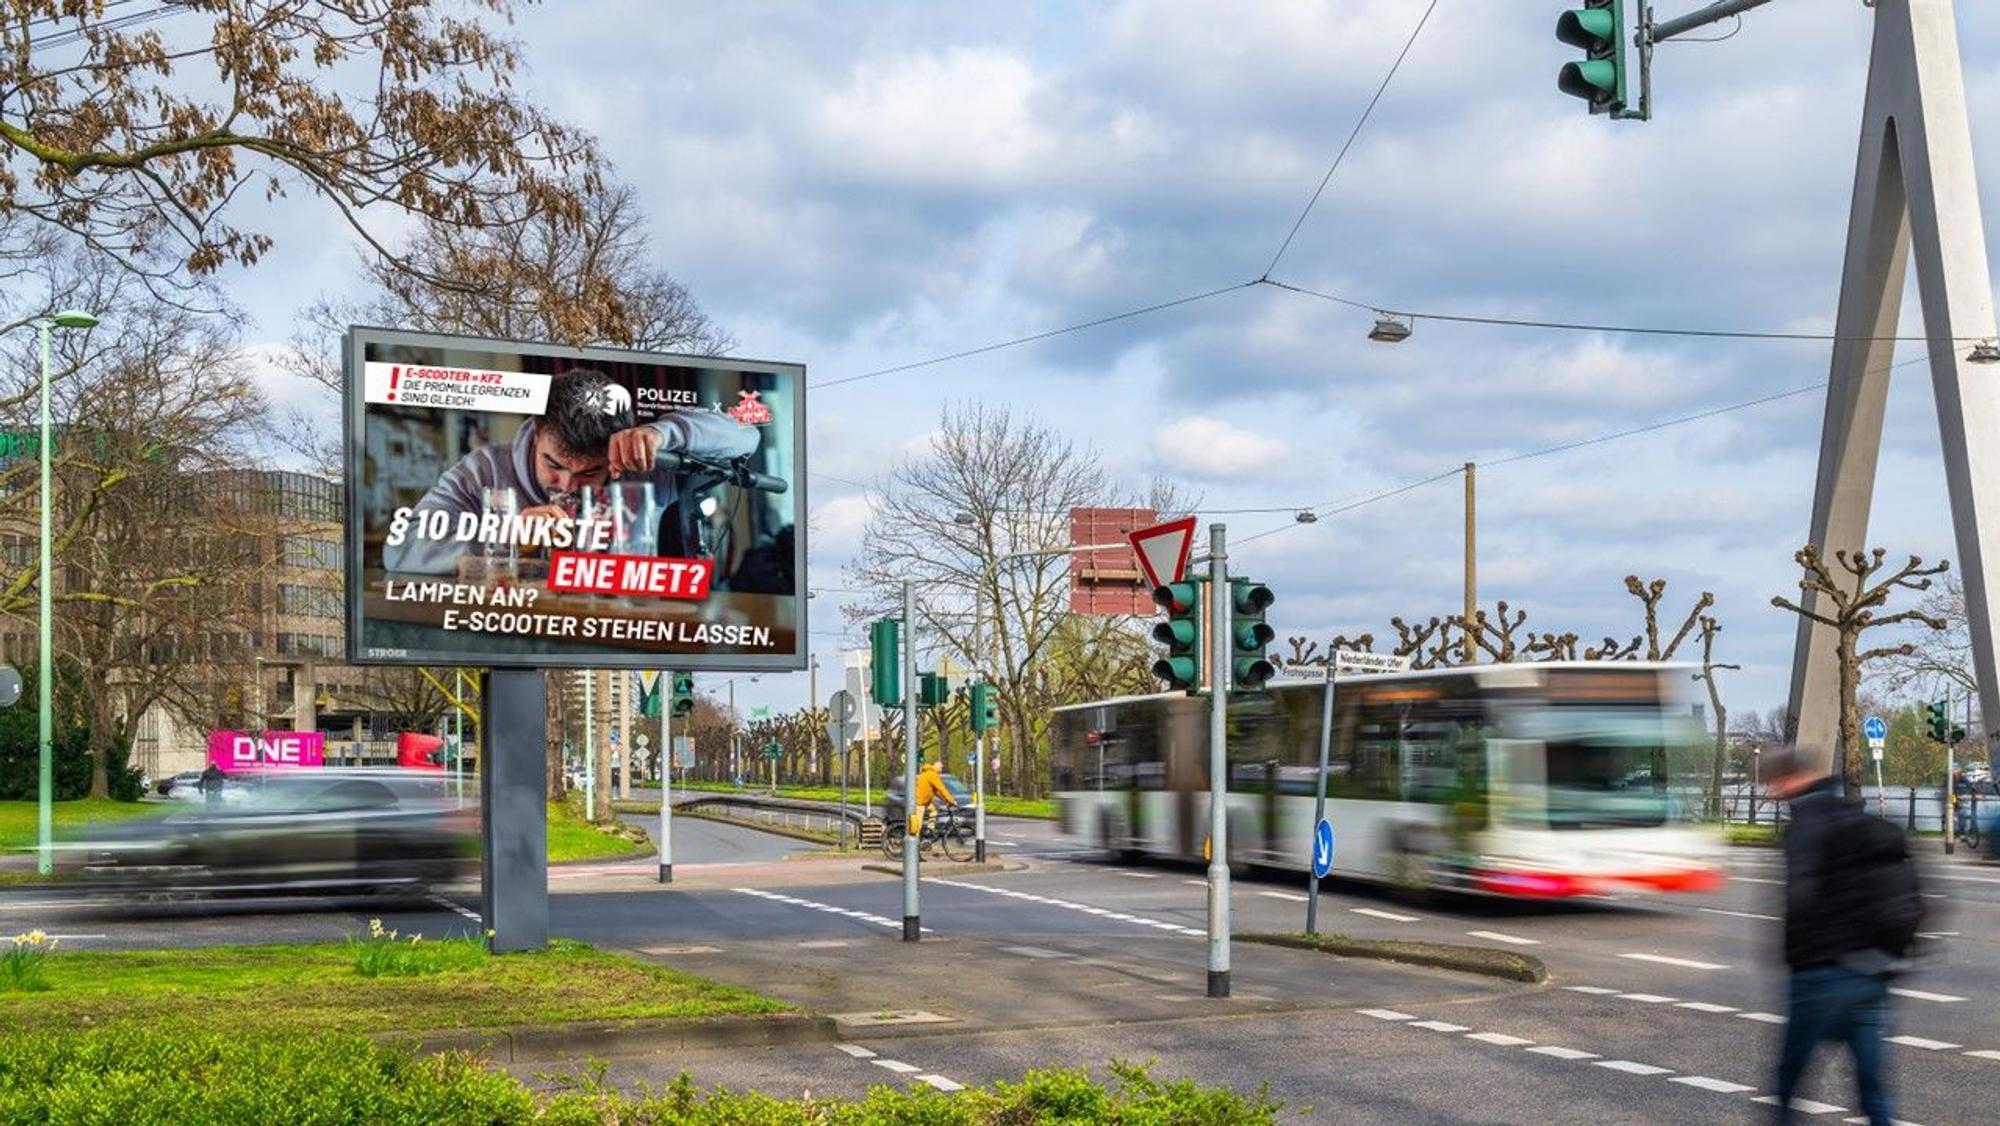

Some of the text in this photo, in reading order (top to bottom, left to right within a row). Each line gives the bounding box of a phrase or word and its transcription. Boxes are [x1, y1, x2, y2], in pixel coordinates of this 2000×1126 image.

[405, 367, 470, 382] E-SCOOTER
[480, 373, 503, 384] KFZ
[400, 391, 429, 404] SIND
[403, 379, 530, 398] DIE PROMILLEGRENZEN
[637, 387, 697, 404] POLIZEI
[416, 508, 449, 541] 10
[455, 511, 612, 550] DRINKSTE
[555, 556, 706, 594] ENE MET?
[385, 580, 539, 608] LAMPEN AN?
[443, 610, 776, 648] E-SCOOTER STEHEN LASSEN.
